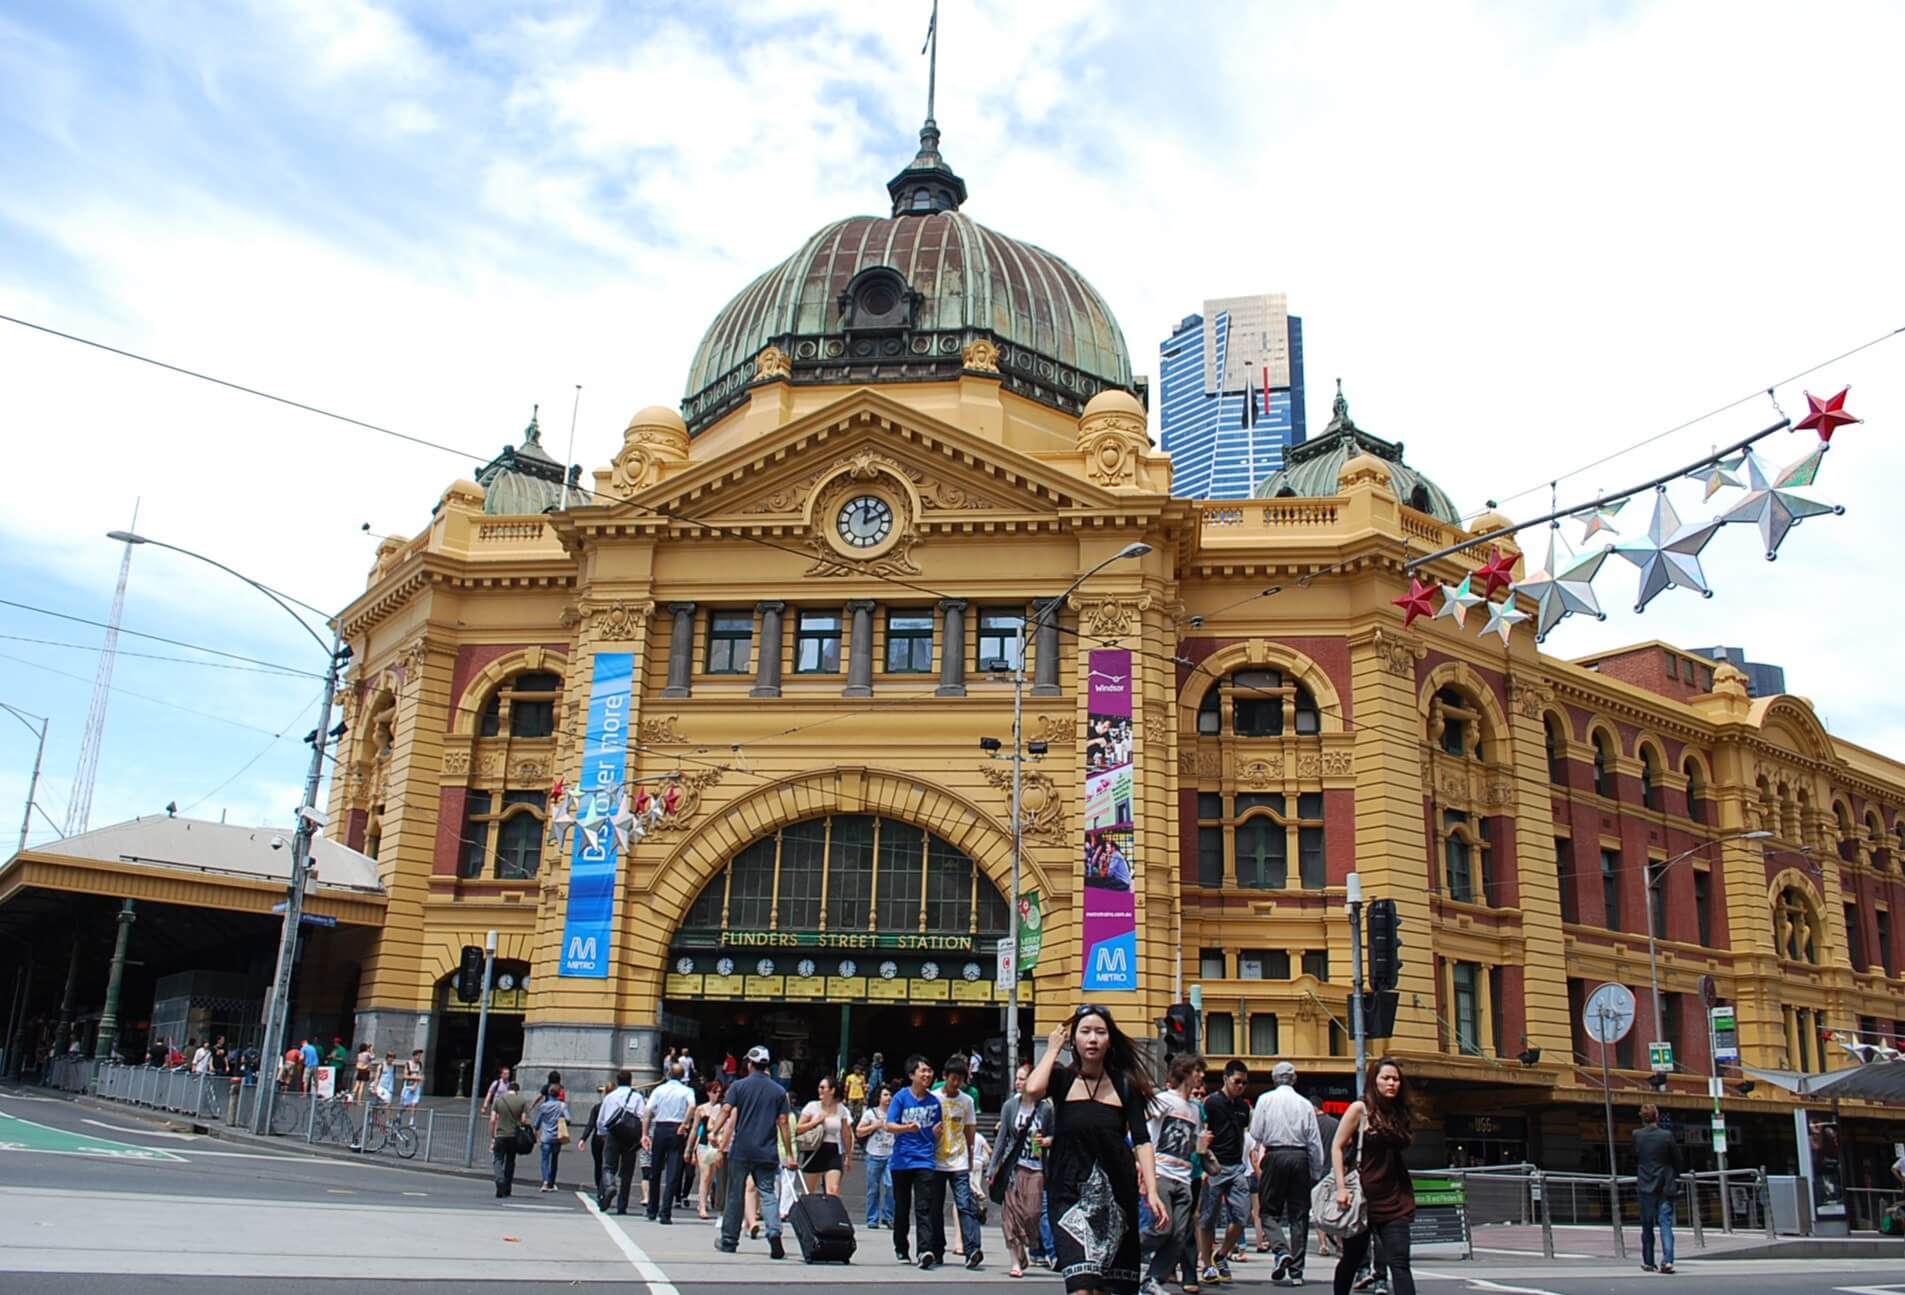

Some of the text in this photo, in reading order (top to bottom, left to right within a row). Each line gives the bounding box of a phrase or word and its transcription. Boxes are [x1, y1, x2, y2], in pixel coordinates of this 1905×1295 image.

[1095, 684, 1124, 693] Windsor
[583, 695, 623, 862] Disover more
[720, 931, 972, 950] FLINDERS STREET STATION
[567, 961, 596, 970] METRO
[1096, 972, 1127, 982] METRO
